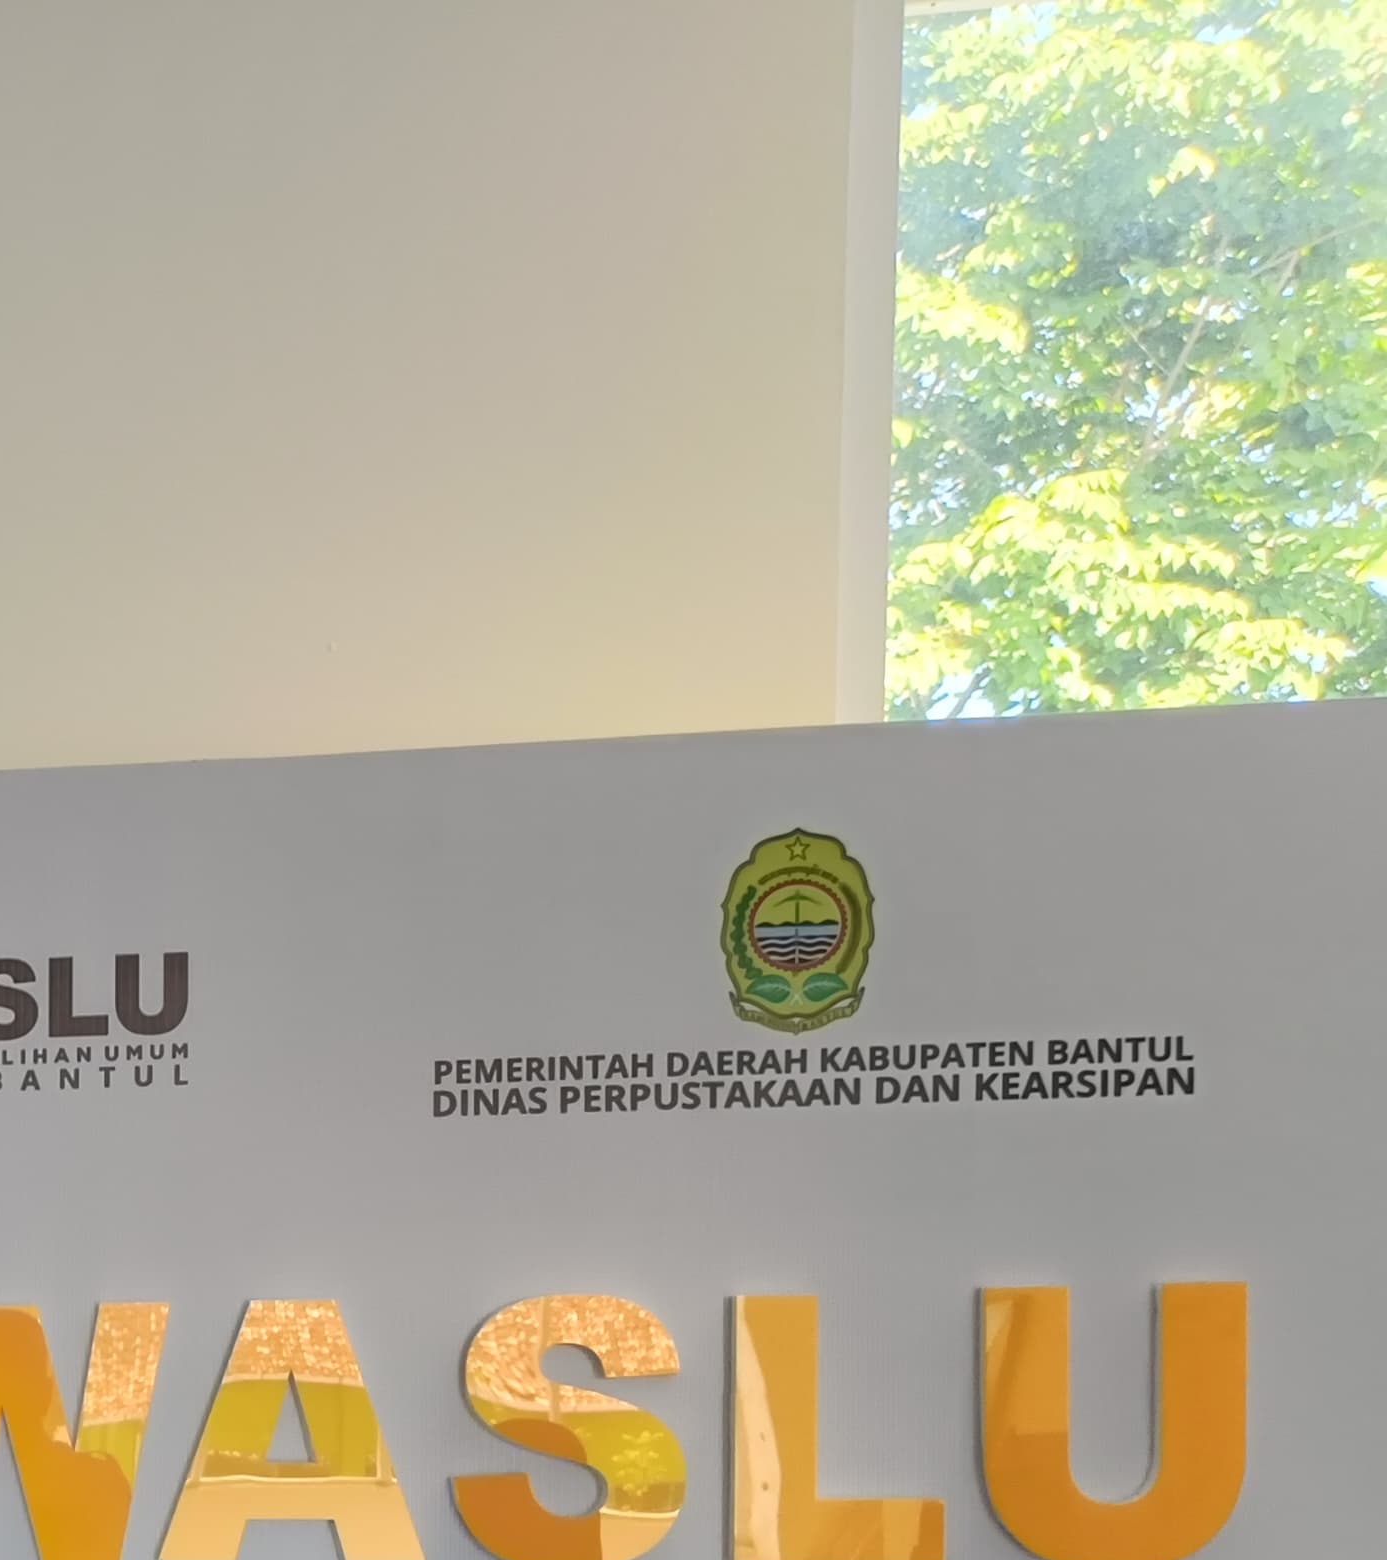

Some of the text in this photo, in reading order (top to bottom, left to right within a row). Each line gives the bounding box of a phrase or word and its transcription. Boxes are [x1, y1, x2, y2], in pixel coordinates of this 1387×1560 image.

[103, 1042, 190, 1063] UMUM
[432, 1034, 1195, 1087] PEMERINTAH DAERAH KABUPATEN BANTUL
[431, 1066, 1197, 1118] DINAS PERPUSTAKAAN DAN KEARSIPAN
